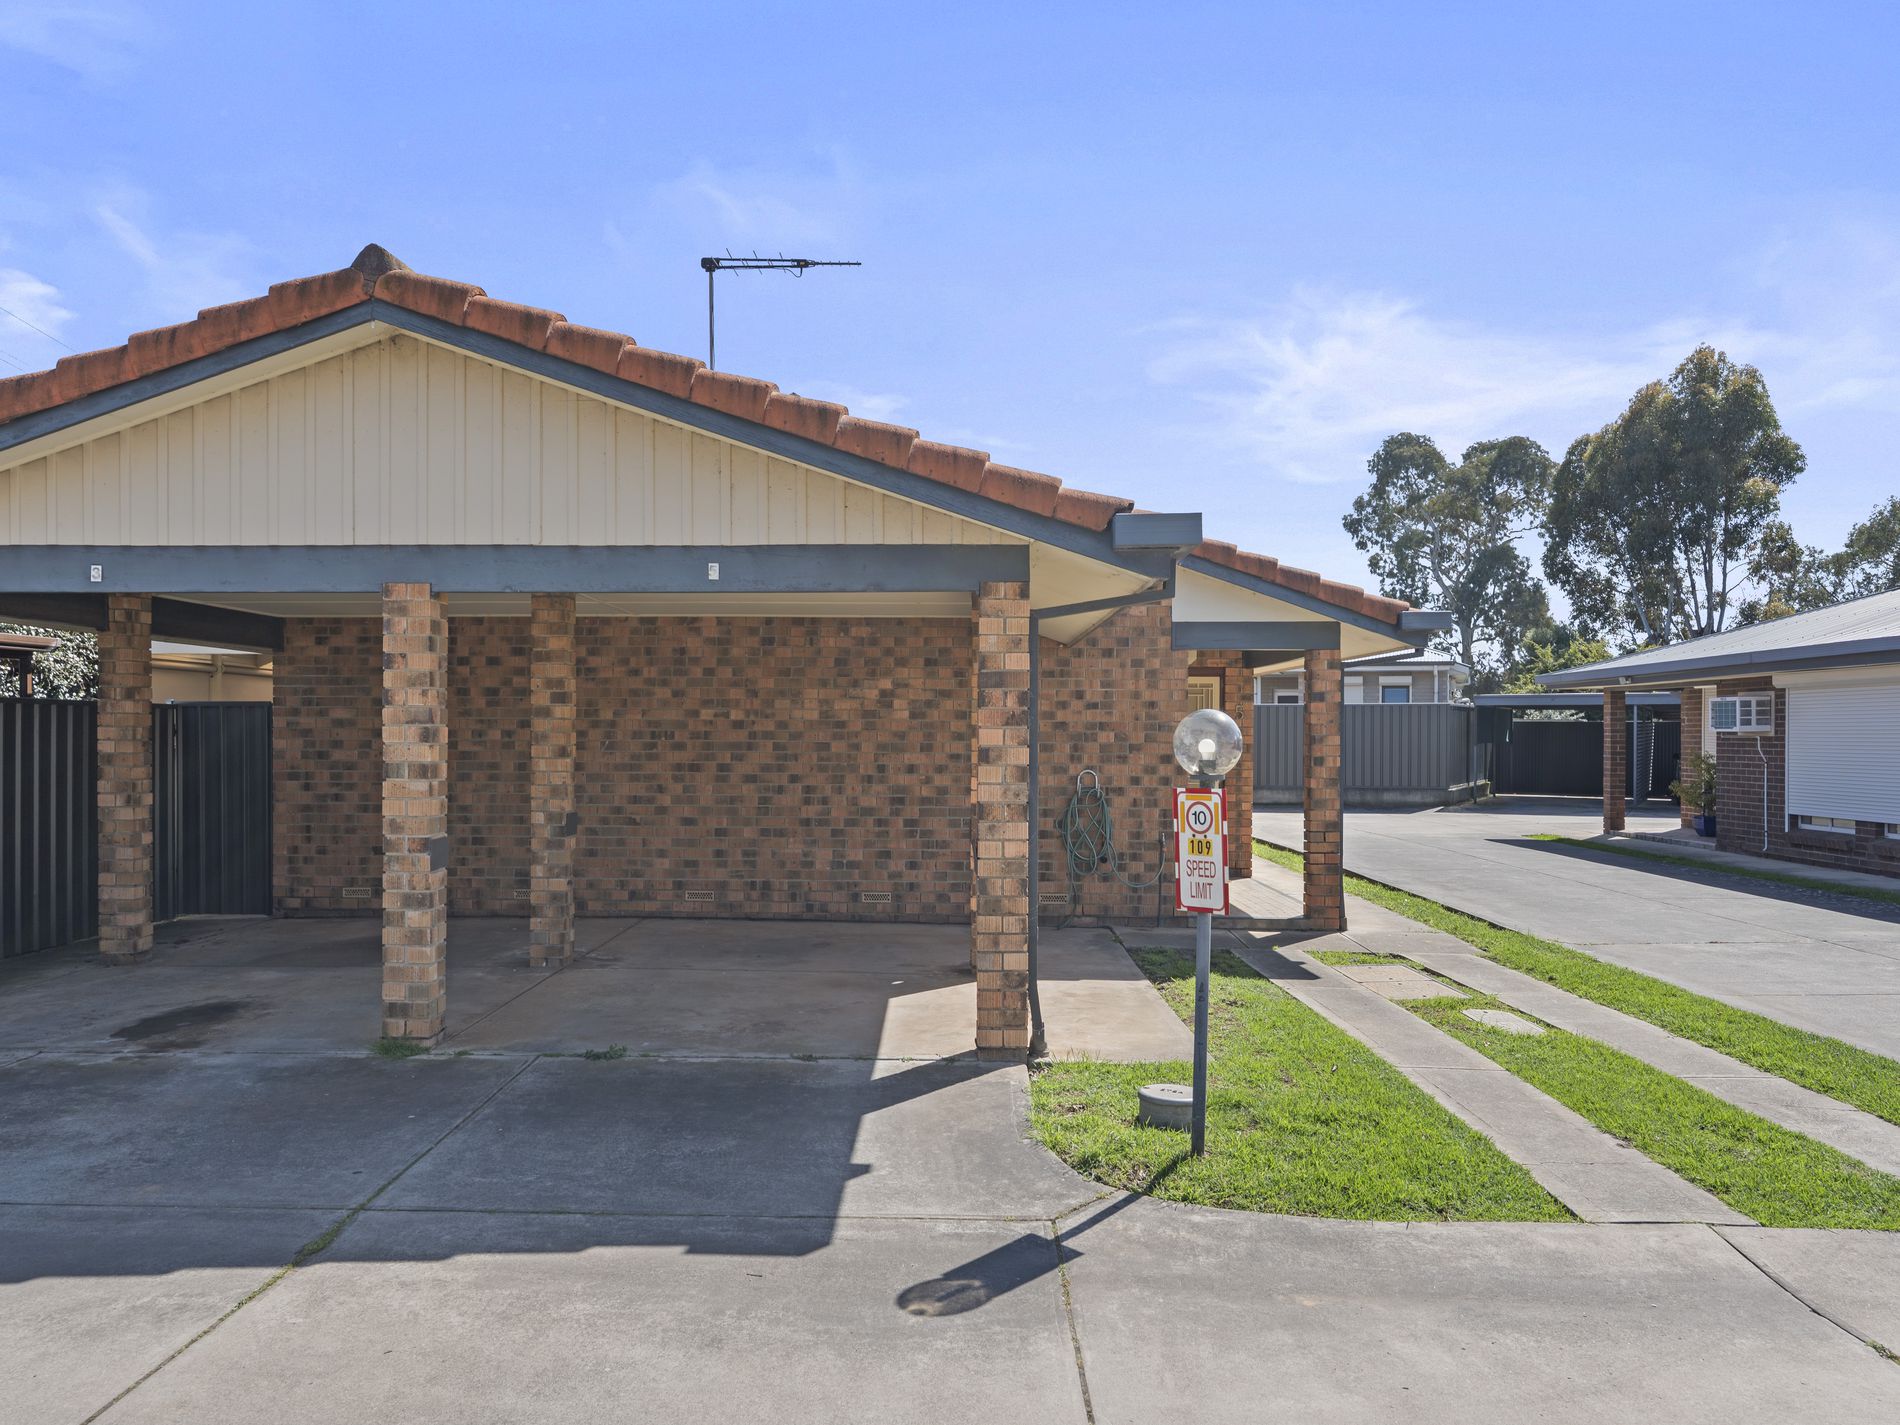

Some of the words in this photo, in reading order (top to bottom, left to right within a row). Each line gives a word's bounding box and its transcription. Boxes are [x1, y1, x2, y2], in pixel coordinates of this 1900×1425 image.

[1192, 811, 1207, 825] 10
[1190, 839, 1211, 856] 109
[1186, 859, 1216, 879] SPEED
[1190, 881, 1213, 900] LIMIT
